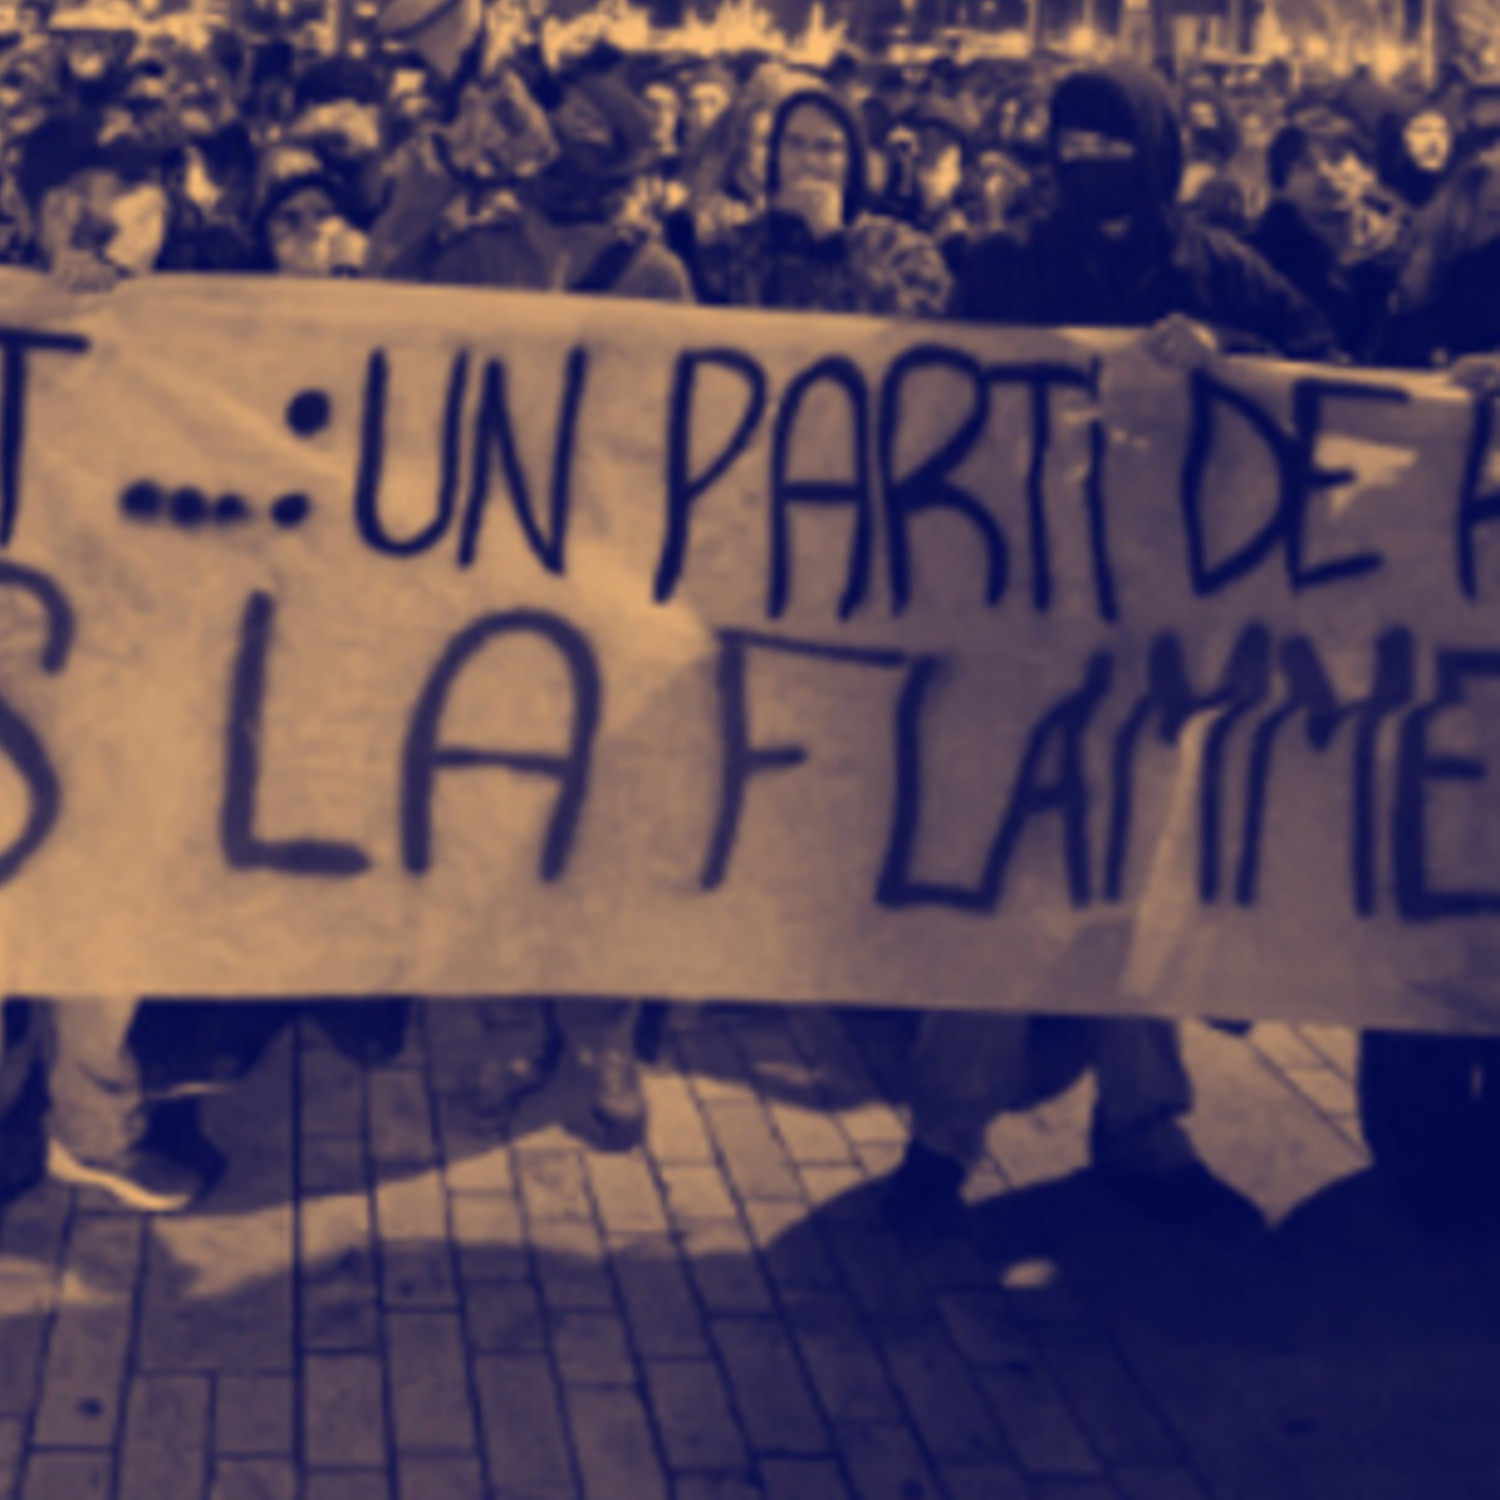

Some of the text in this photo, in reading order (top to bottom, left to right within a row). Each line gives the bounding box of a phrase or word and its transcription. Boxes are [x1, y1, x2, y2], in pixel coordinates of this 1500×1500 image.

[1182, 370, 1412, 596] DE
[220, 592, 602, 884] LA
[700, 622, 1500, 922] FLAMME
